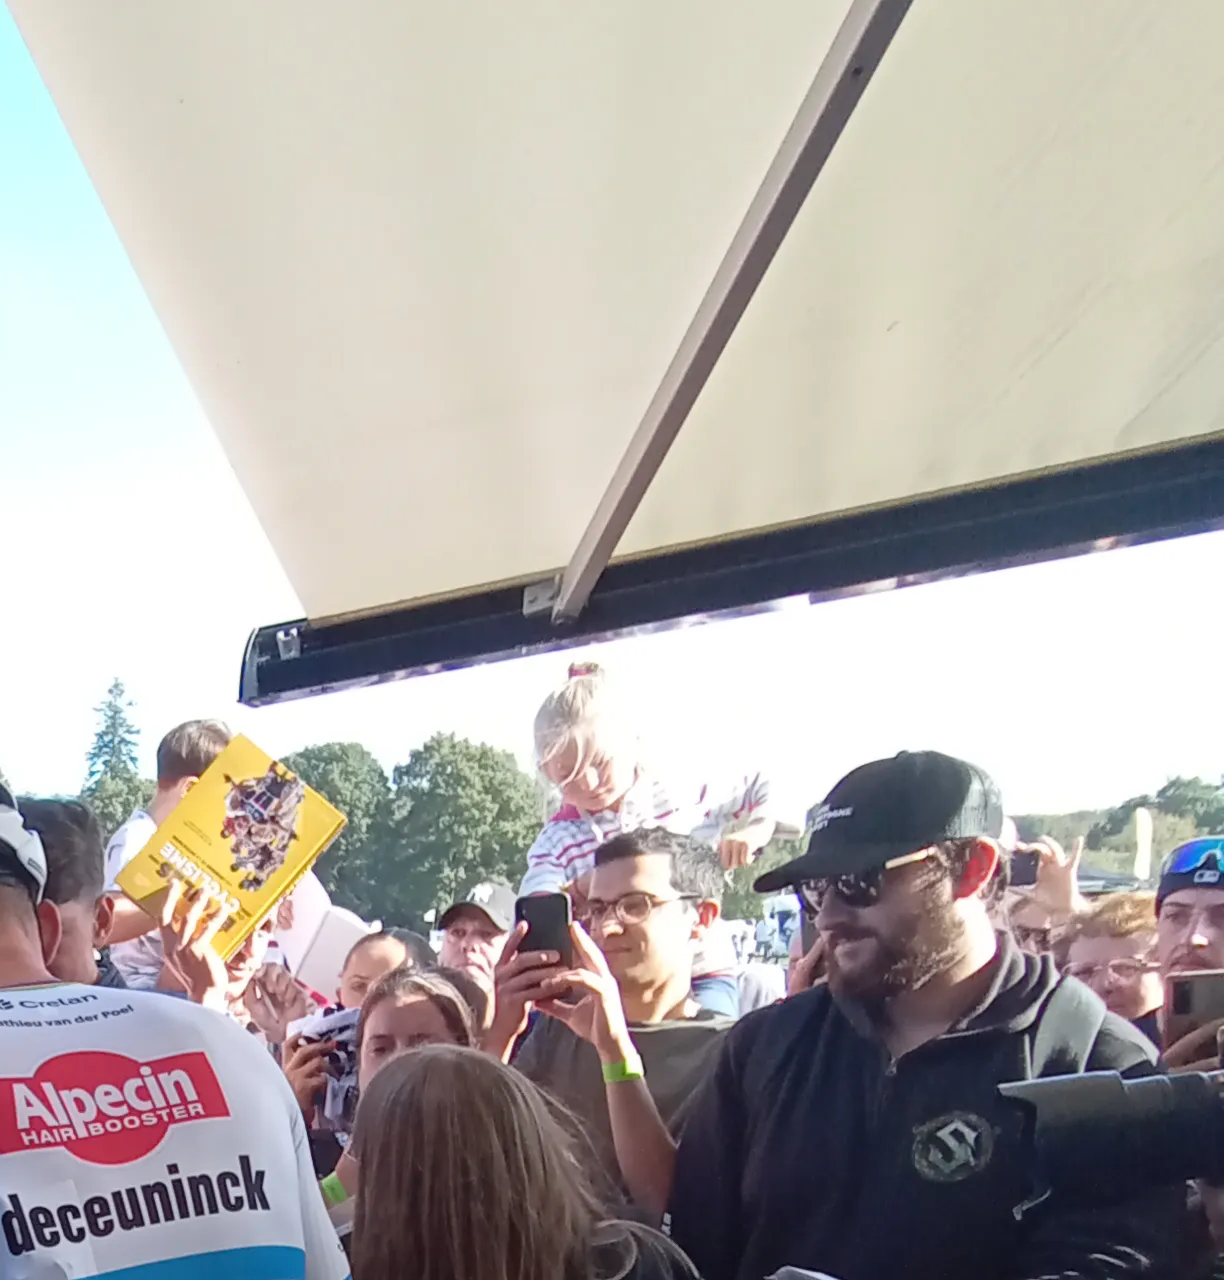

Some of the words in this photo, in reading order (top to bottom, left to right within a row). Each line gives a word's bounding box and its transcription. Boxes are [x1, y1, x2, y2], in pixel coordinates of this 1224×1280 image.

[19, 993, 98, 1009] Crelan
[45, 1018, 72, 1027] van
[74, 1013, 99, 1024] der
[101, 1003, 135, 1019] Poel
[12, 1066, 198, 1139] Alpecin
[21, 1127, 76, 1146] HAIR
[87, 1102, 206, 1137] BOOSTER
[1, 1155, 271, 1256] deceuninck
